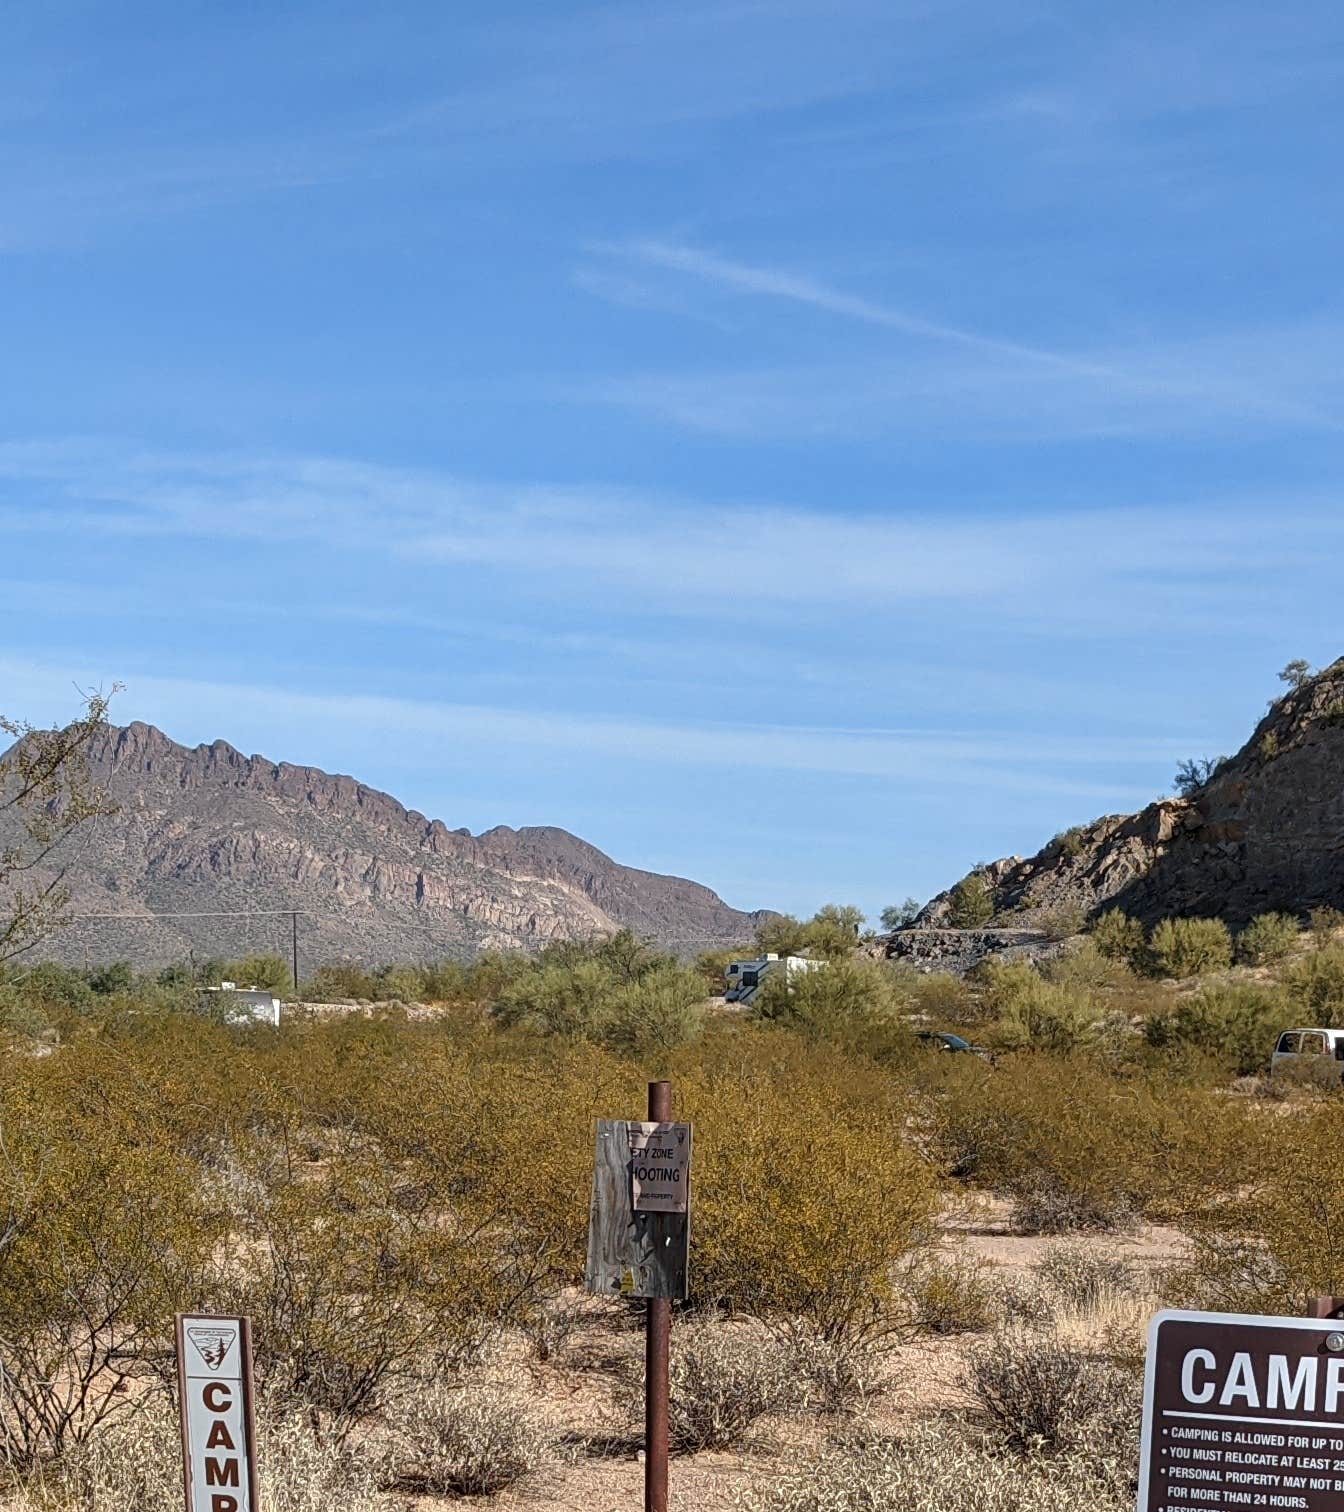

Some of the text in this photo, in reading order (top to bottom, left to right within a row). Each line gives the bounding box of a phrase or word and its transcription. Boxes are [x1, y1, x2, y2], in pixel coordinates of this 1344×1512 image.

[651, 1148, 674, 1159] ZONE
[1171, 1427, 1219, 1442] CAMPING
[1221, 1431, 1233, 1443] IS
[1233, 1432, 1286, 1447] ALLOWED
[1287, 1435, 1310, 1449] FOR
[1311, 1437, 1328, 1450] UP
[1328, 1438, 1344, 1451] TO
[1169, 1447, 1191, 1459] YOU
[1192, 1448, 1223, 1462] MUST
[1224, 1451, 1279, 1467] RELOCATE
[1279, 1455, 1295, 1468] AT
[1296, 1456, 1332, 1471] LEAST
[1168, 1466, 1223, 1482] PERSONAL
[1225, 1471, 1281, 1487] PROPERTY
[1283, 1475, 1308, 1489] MAY
[1309, 1478, 1333, 1491] NOT
[1167, 1486, 1310, 1509] FOR MORE THAN 24 HOURS.
